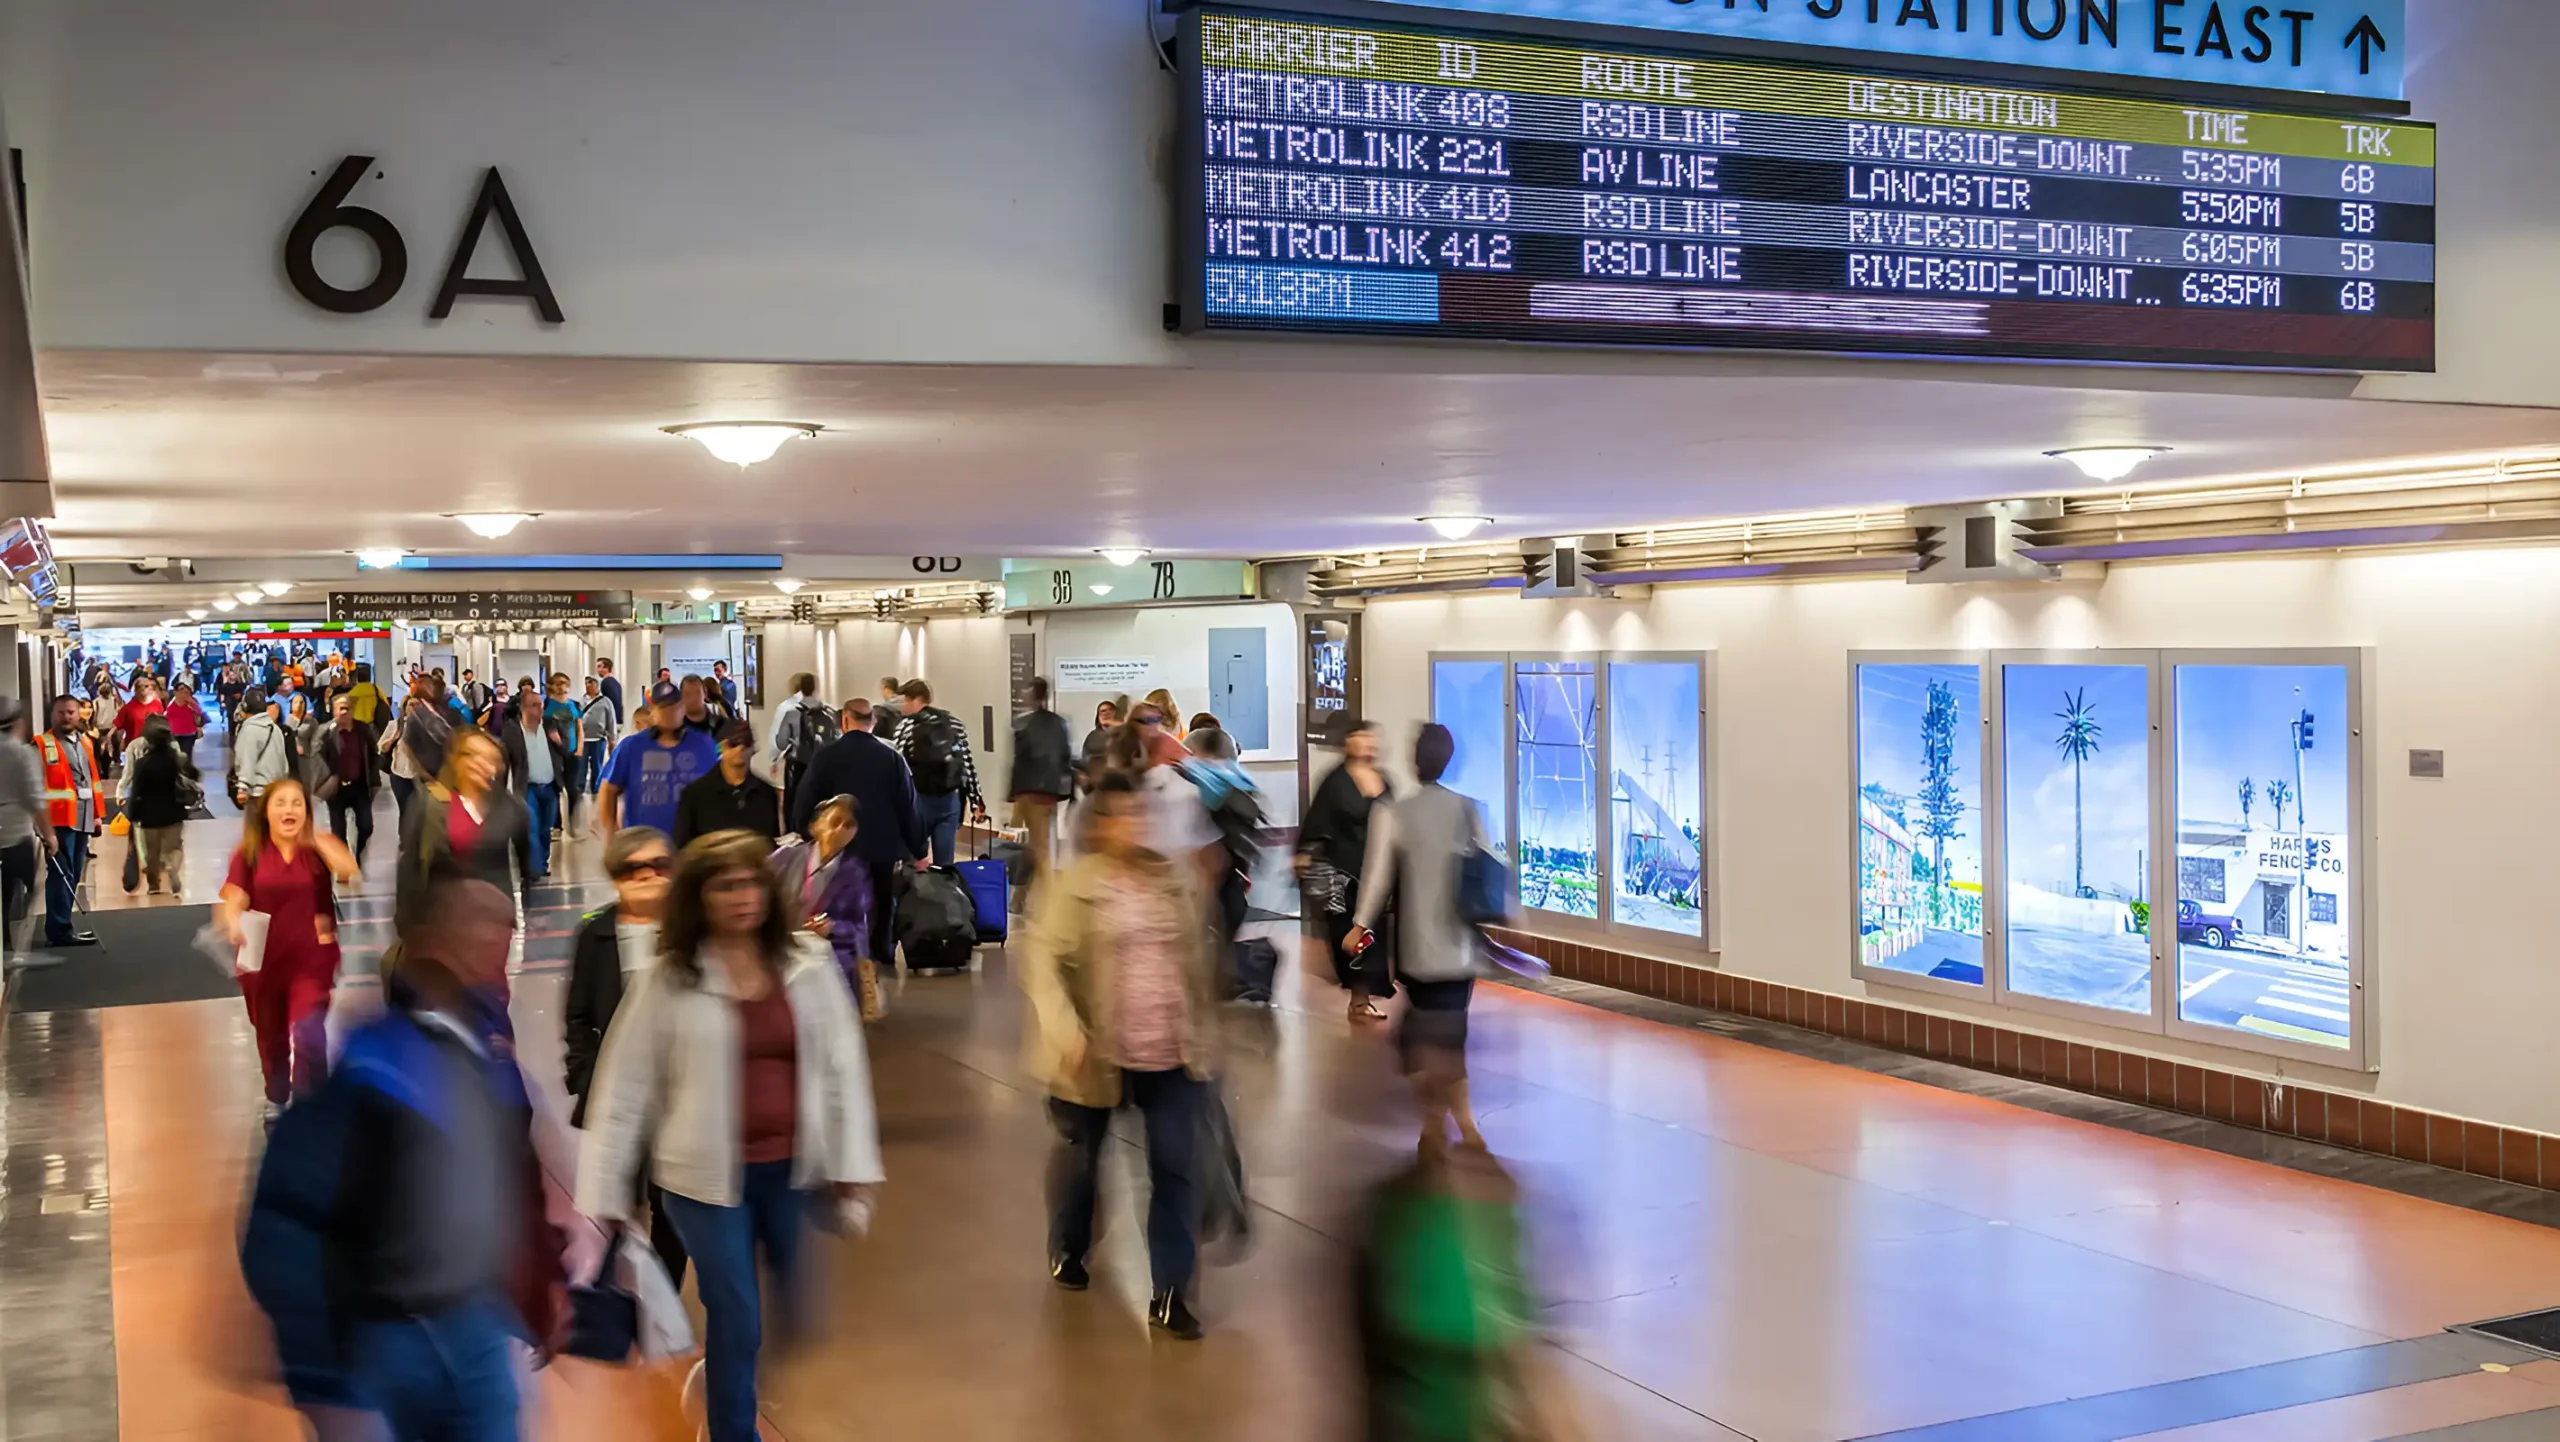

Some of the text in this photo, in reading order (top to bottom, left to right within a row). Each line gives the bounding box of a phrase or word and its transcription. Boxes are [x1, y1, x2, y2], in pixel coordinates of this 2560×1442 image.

[2153, 0, 2314, 67] EAST
[1204, 69, 1429, 122] METROLINK
[1438, 91, 1510, 128] 408
[1582, 101, 1650, 137] RSD
[1659, 108, 1741, 145] LINE
[2182, 151, 2281, 187] 5:35PM
[2341, 163, 2375, 194] 6B
[1205, 20, 2392, 157] CARRIER ID ROUTE DESTINATION TIME TRK
[1206, 166, 1431, 218] METROLINK
[1439, 185, 1511, 222] 410
[1583, 193, 1651, 230] RSD
[1660, 199, 1741, 235] LINE
[2182, 232, 2281, 267] 6:05PM
[2341, 242, 2375, 272] 5B
[1207, 119, 2375, 233] METROLINK 221 AV LINE LANCASTER 5:50PM 5B
[285, 155, 565, 322] 6A
[1206, 267, 1351, 308] 5:13PM
[1208, 217, 1431, 266] METROLINK
[1440, 231, 1512, 269] 412
[1584, 239, 1652, 275] RSD
[1660, 243, 1742, 280] LINE
[2182, 273, 2281, 307] 6:35PM
[2341, 281, 2375, 312] 6B
[1150, 561, 1176, 599] 7B
[2270, 836, 2331, 854] HARS
